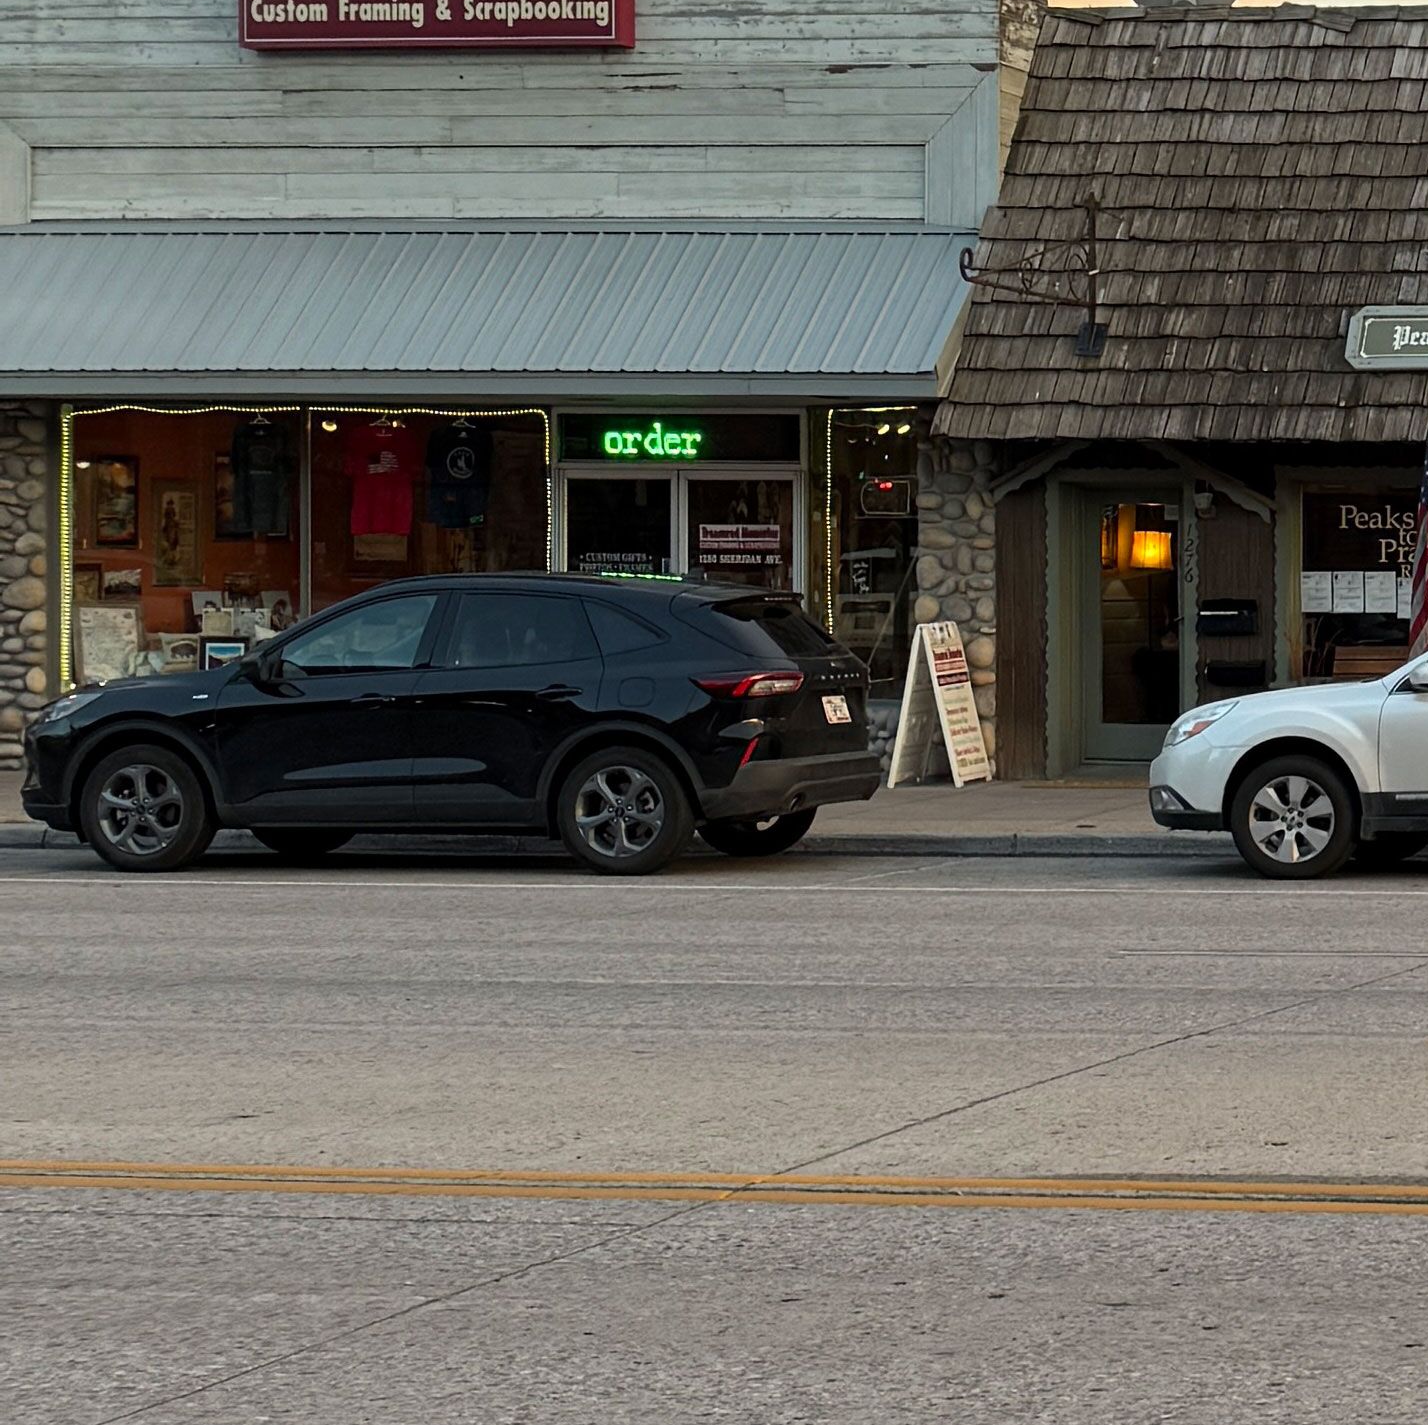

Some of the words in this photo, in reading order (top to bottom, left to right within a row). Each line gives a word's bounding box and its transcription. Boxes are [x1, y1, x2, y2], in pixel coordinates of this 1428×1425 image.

[604, 422, 701, 455] order
[1339, 505, 1415, 529] Peaks
[1184, 523, 1194, 583] 1276
